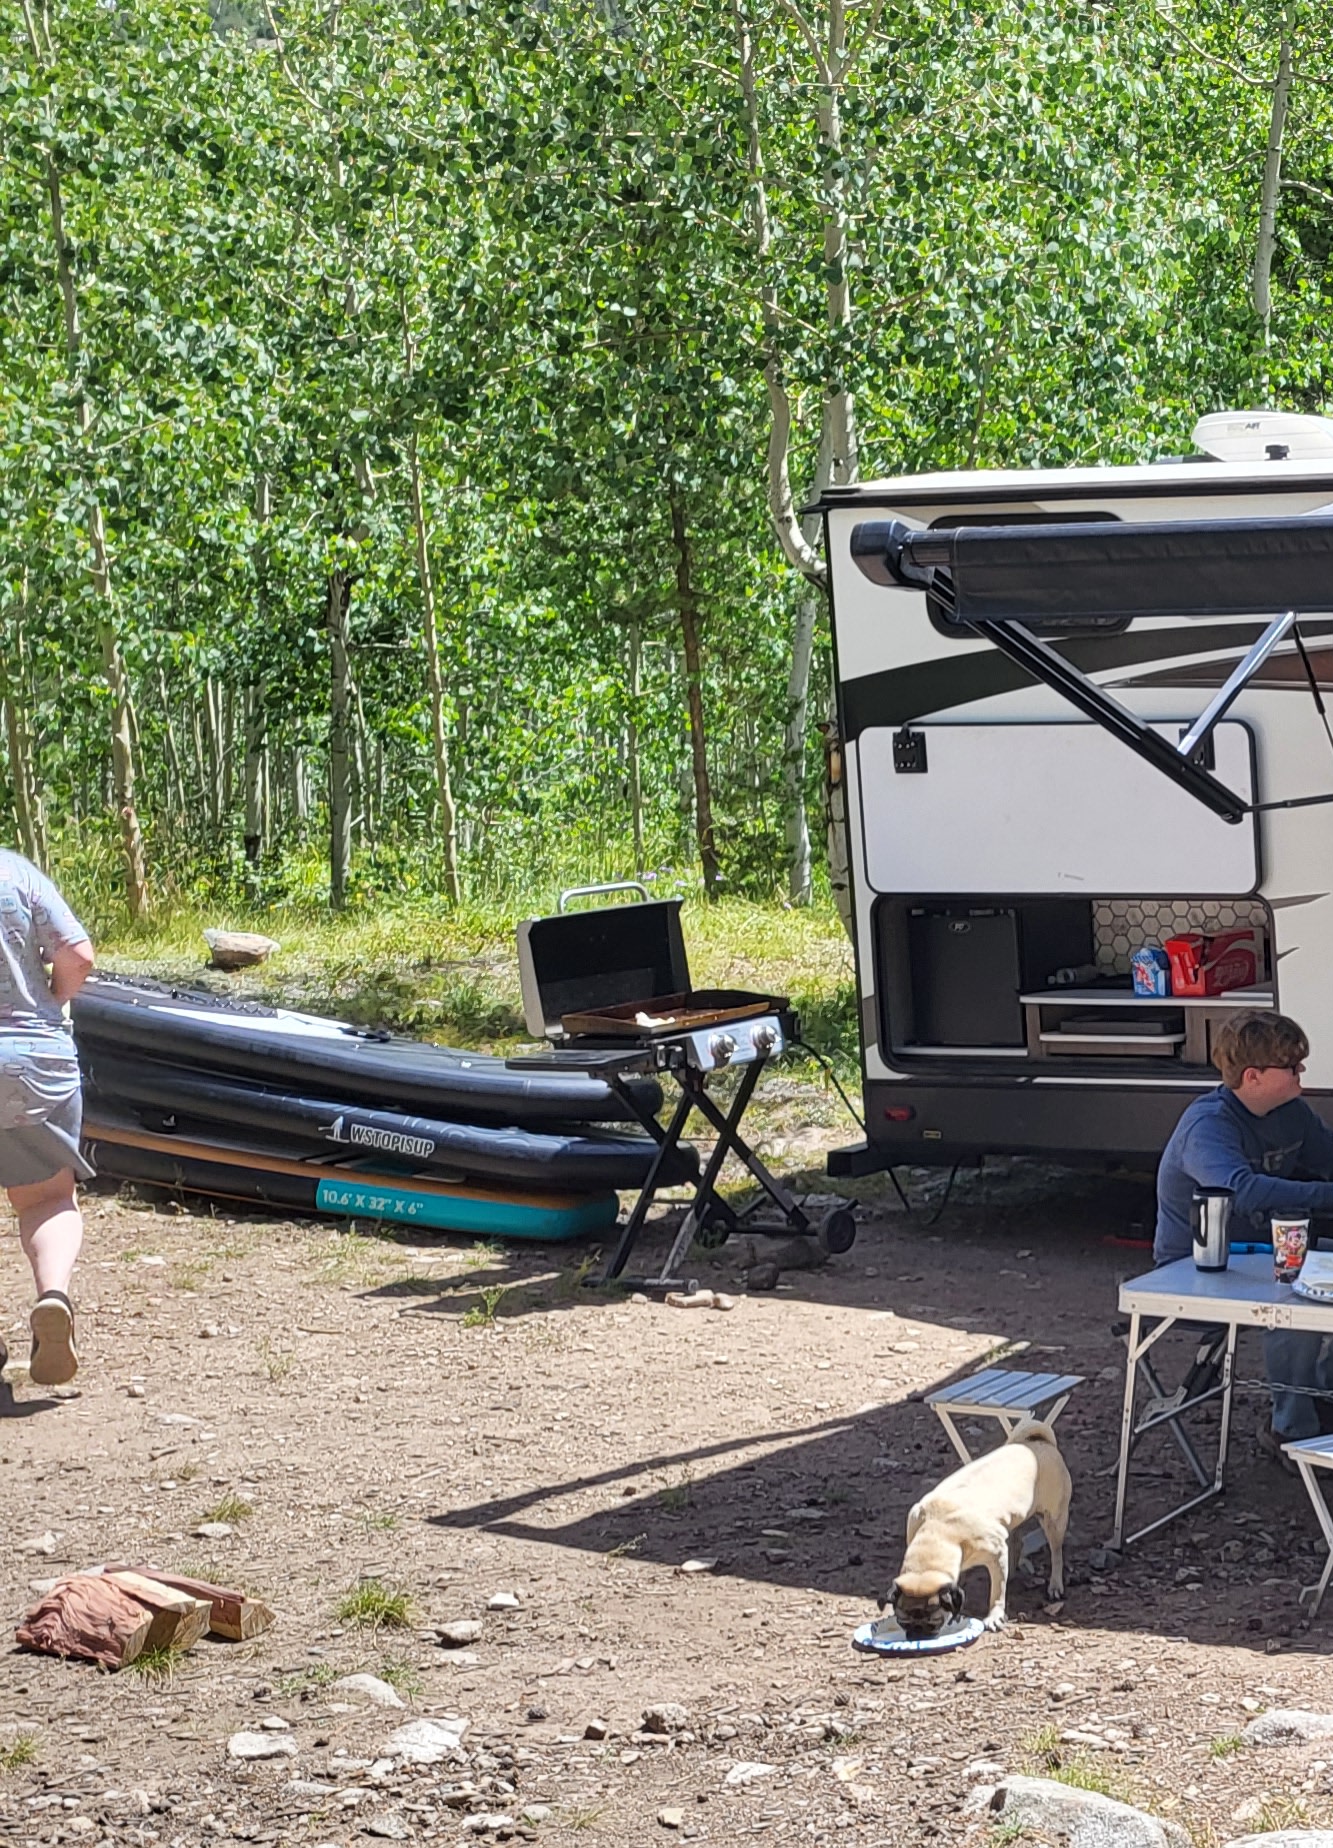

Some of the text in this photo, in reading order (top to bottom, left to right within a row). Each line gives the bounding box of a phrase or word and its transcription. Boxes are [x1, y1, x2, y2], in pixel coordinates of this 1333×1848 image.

[351, 1123, 435, 1158] WSTOPISUP
[355, 1194, 366, 1209] X
[394, 1199, 406, 1214] X
